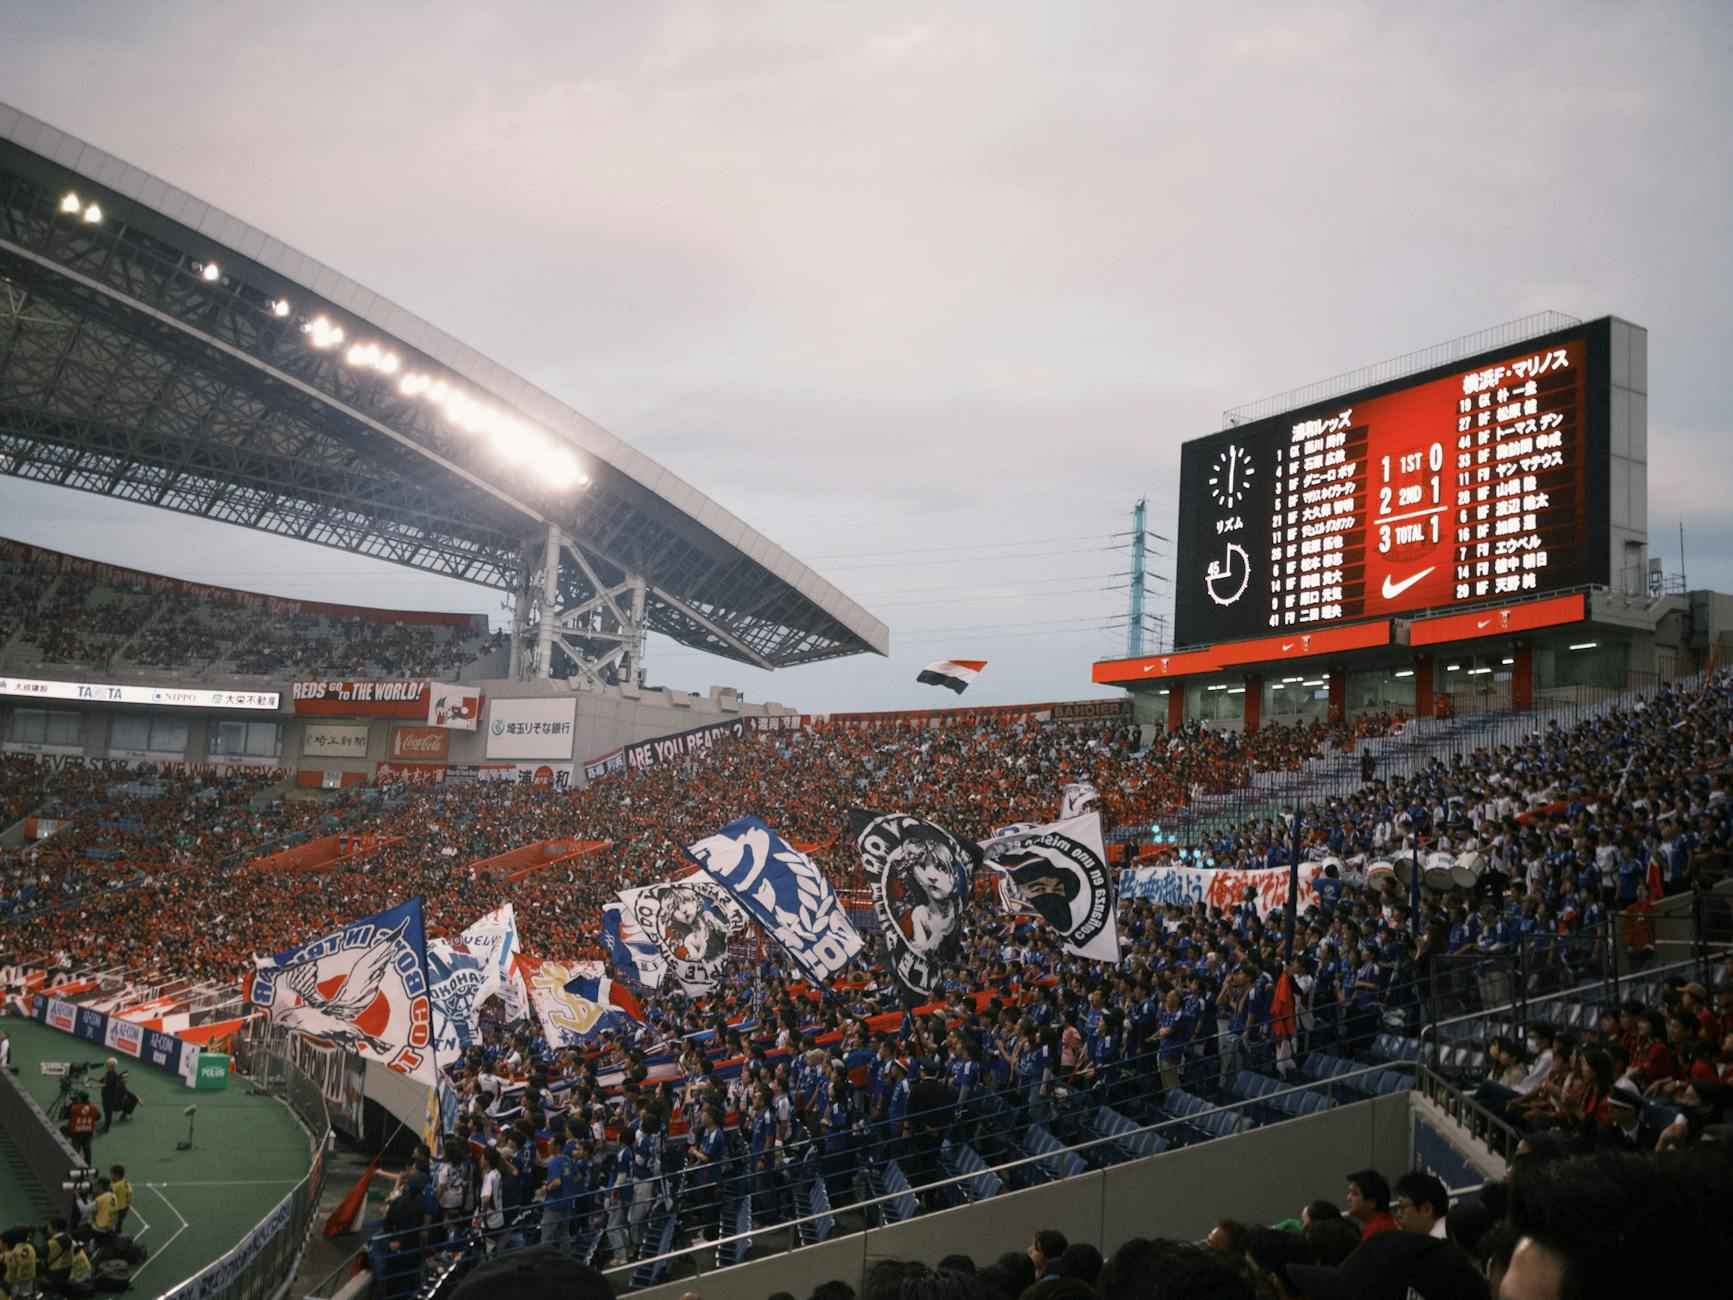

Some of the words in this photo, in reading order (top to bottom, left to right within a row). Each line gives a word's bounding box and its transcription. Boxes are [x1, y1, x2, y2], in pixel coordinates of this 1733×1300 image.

[1382, 455, 1391, 483] 1
[1400, 452, 1423, 473] 1ST
[1429, 442, 1443, 472] 0
[1380, 487, 1392, 515] 2
[1399, 485, 1422, 506] 2ND
[1430, 475, 1440, 503] 1
[1216, 516, 1243, 534] リズム
[1379, 524, 1391, 553] 3
[1395, 523, 1425, 544] TOTAL
[1430, 515, 1439, 543] 1
[1460, 547, 1467, 561] 7
[1208, 560, 1220, 576] 45
[293, 682, 326, 699] REDS
[352, 682, 374, 700] THE
[375, 682, 424, 700] WORLD!
[507, 722, 571, 736] 埼玉りそな銀行
[628, 744, 654, 770] ARE
[655, 737, 684, 763] YOU
